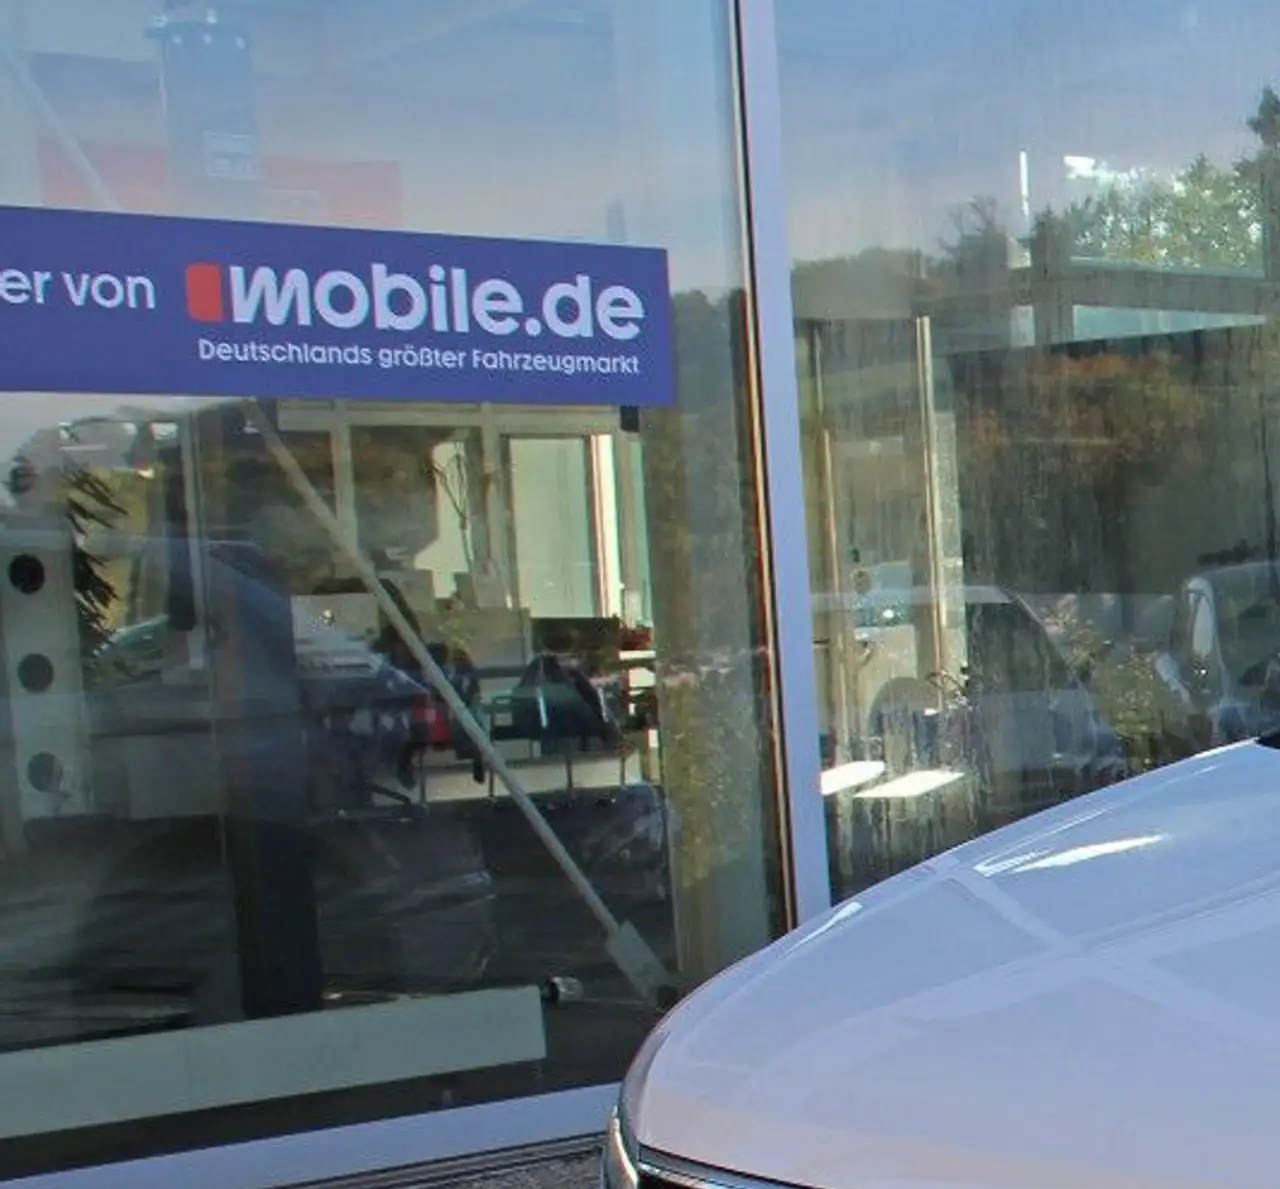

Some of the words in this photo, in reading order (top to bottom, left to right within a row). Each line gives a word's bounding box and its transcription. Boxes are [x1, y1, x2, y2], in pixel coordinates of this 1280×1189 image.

[61, 271, 156, 309] von
[229, 263, 645, 340] mobile.de
[199, 338, 372, 366] Deutschlands
[378, 344, 465, 370] größter
[472, 349, 640, 375] Fahrzeugmarkt
